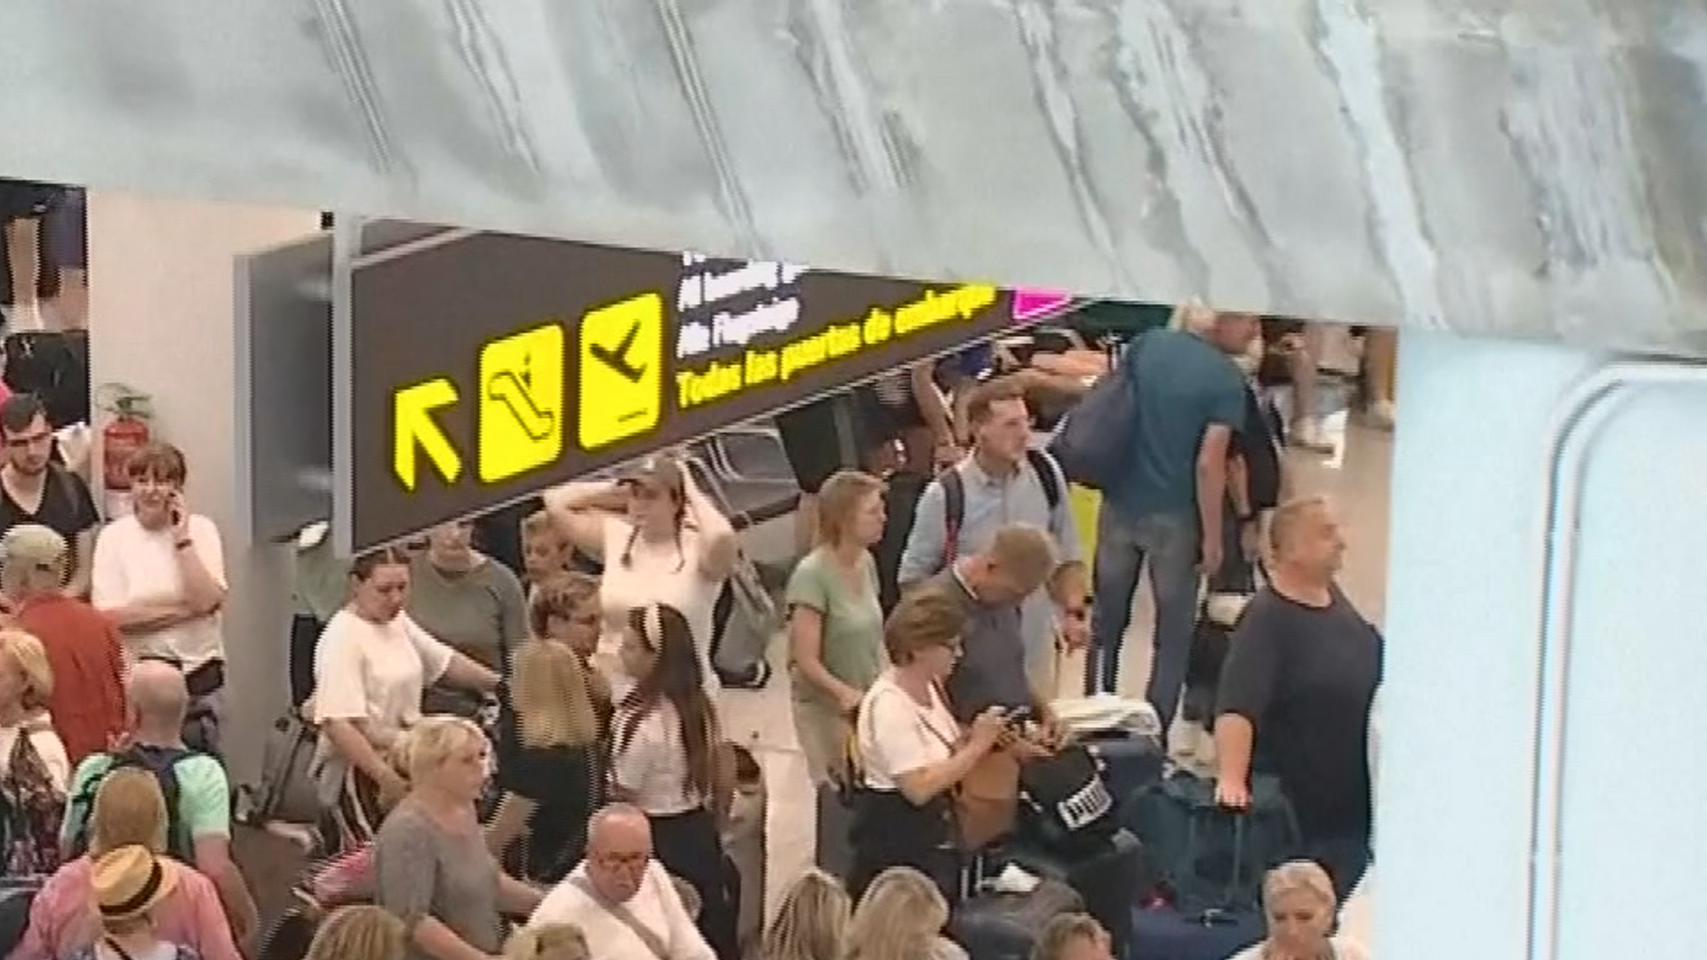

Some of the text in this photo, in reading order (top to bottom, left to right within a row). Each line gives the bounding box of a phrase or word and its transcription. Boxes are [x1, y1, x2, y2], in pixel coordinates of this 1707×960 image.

[675, 361, 742, 409] Todas
[745, 350, 778, 385] las
[780, 323, 862, 381] puertas
[863, 307, 892, 345] de
